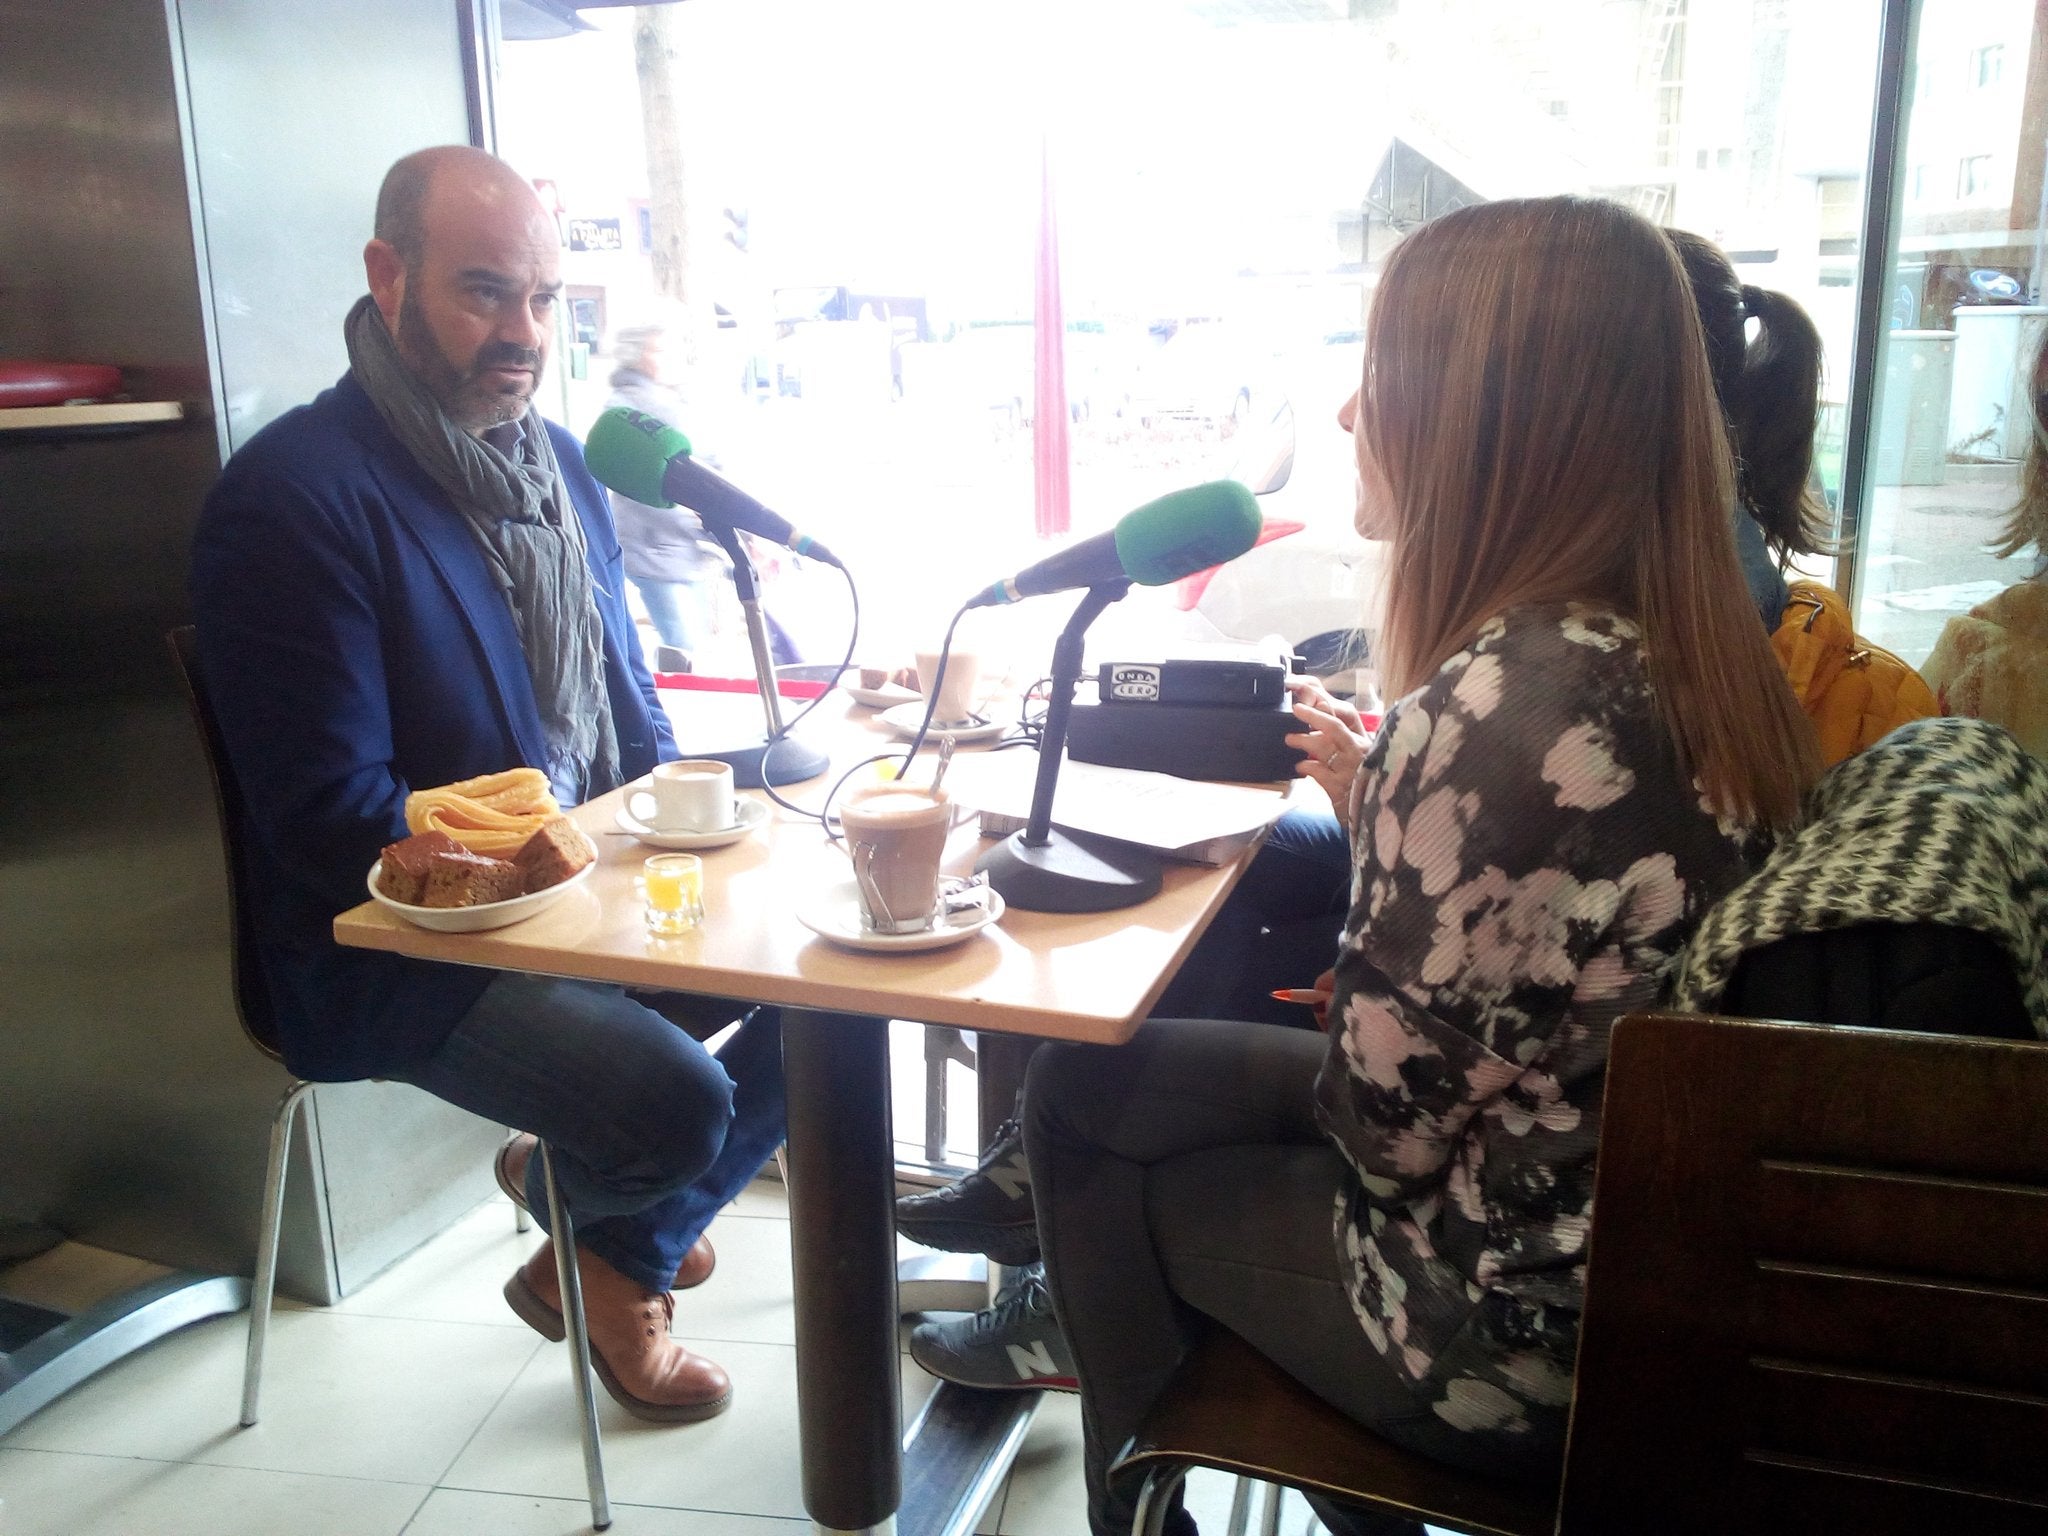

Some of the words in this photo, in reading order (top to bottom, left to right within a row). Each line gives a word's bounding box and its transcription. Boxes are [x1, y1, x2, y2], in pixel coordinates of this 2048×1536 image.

[1118, 672, 1152, 682] ONDA
[1120, 685, 1152, 695] CERO
[1005, 1340, 1059, 1380] N
